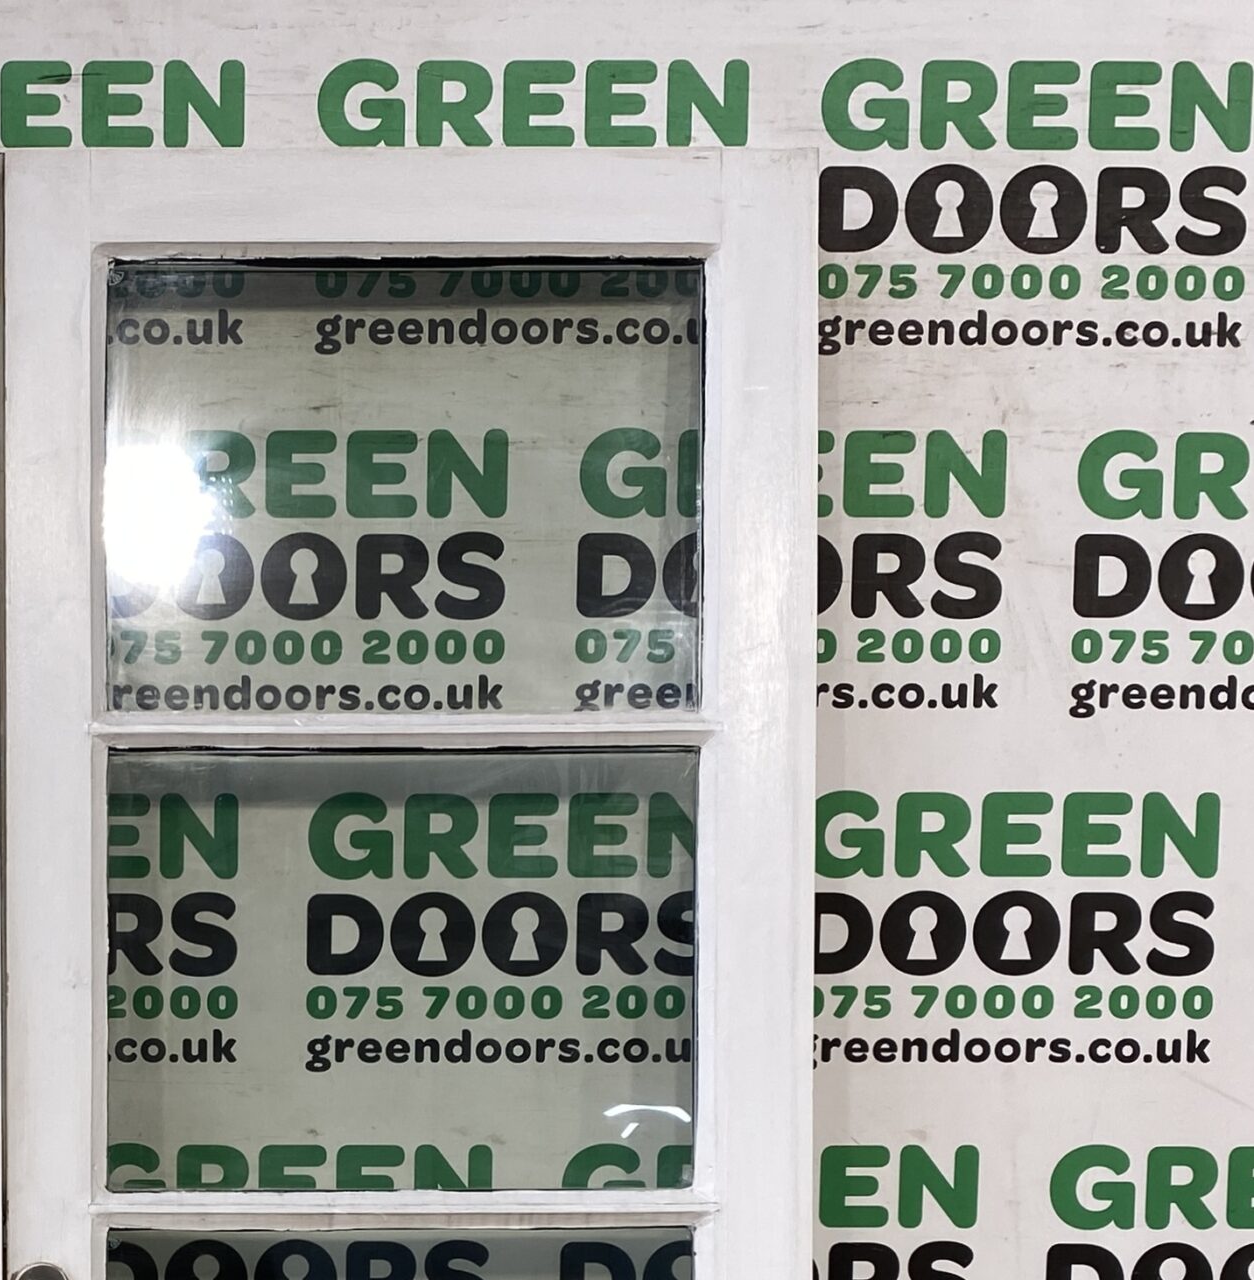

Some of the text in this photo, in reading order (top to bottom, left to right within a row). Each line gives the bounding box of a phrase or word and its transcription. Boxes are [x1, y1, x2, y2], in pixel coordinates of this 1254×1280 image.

[318, 59, 749, 147] GREEN
[821, 58, 1253, 152] GREEN
[818, 164, 1246, 256] DOORS
[818, 263, 1245, 301] 075 7000 2000
[818, 310, 1241, 355] greendoors.co.uk
[187, 429, 509, 518] REEN
[110, 531, 505, 621] OORS
[110, 625, 505, 665] 75 7000 2000
[575, 629, 675, 664] 075
[857, 629, 1001, 663] 2000
[1071, 629, 1169, 664] 075
[814, 790, 1220, 879] GREEN
[813, 891, 1214, 976] DOORS
[306, 986, 403, 1019] 075
[423, 986, 562, 1019] 7000
[911, 985, 1054, 1019] 7000
[1074, 985, 1213, 1019] 2000
[814, 1029, 1210, 1070] reendoors.co.uk
